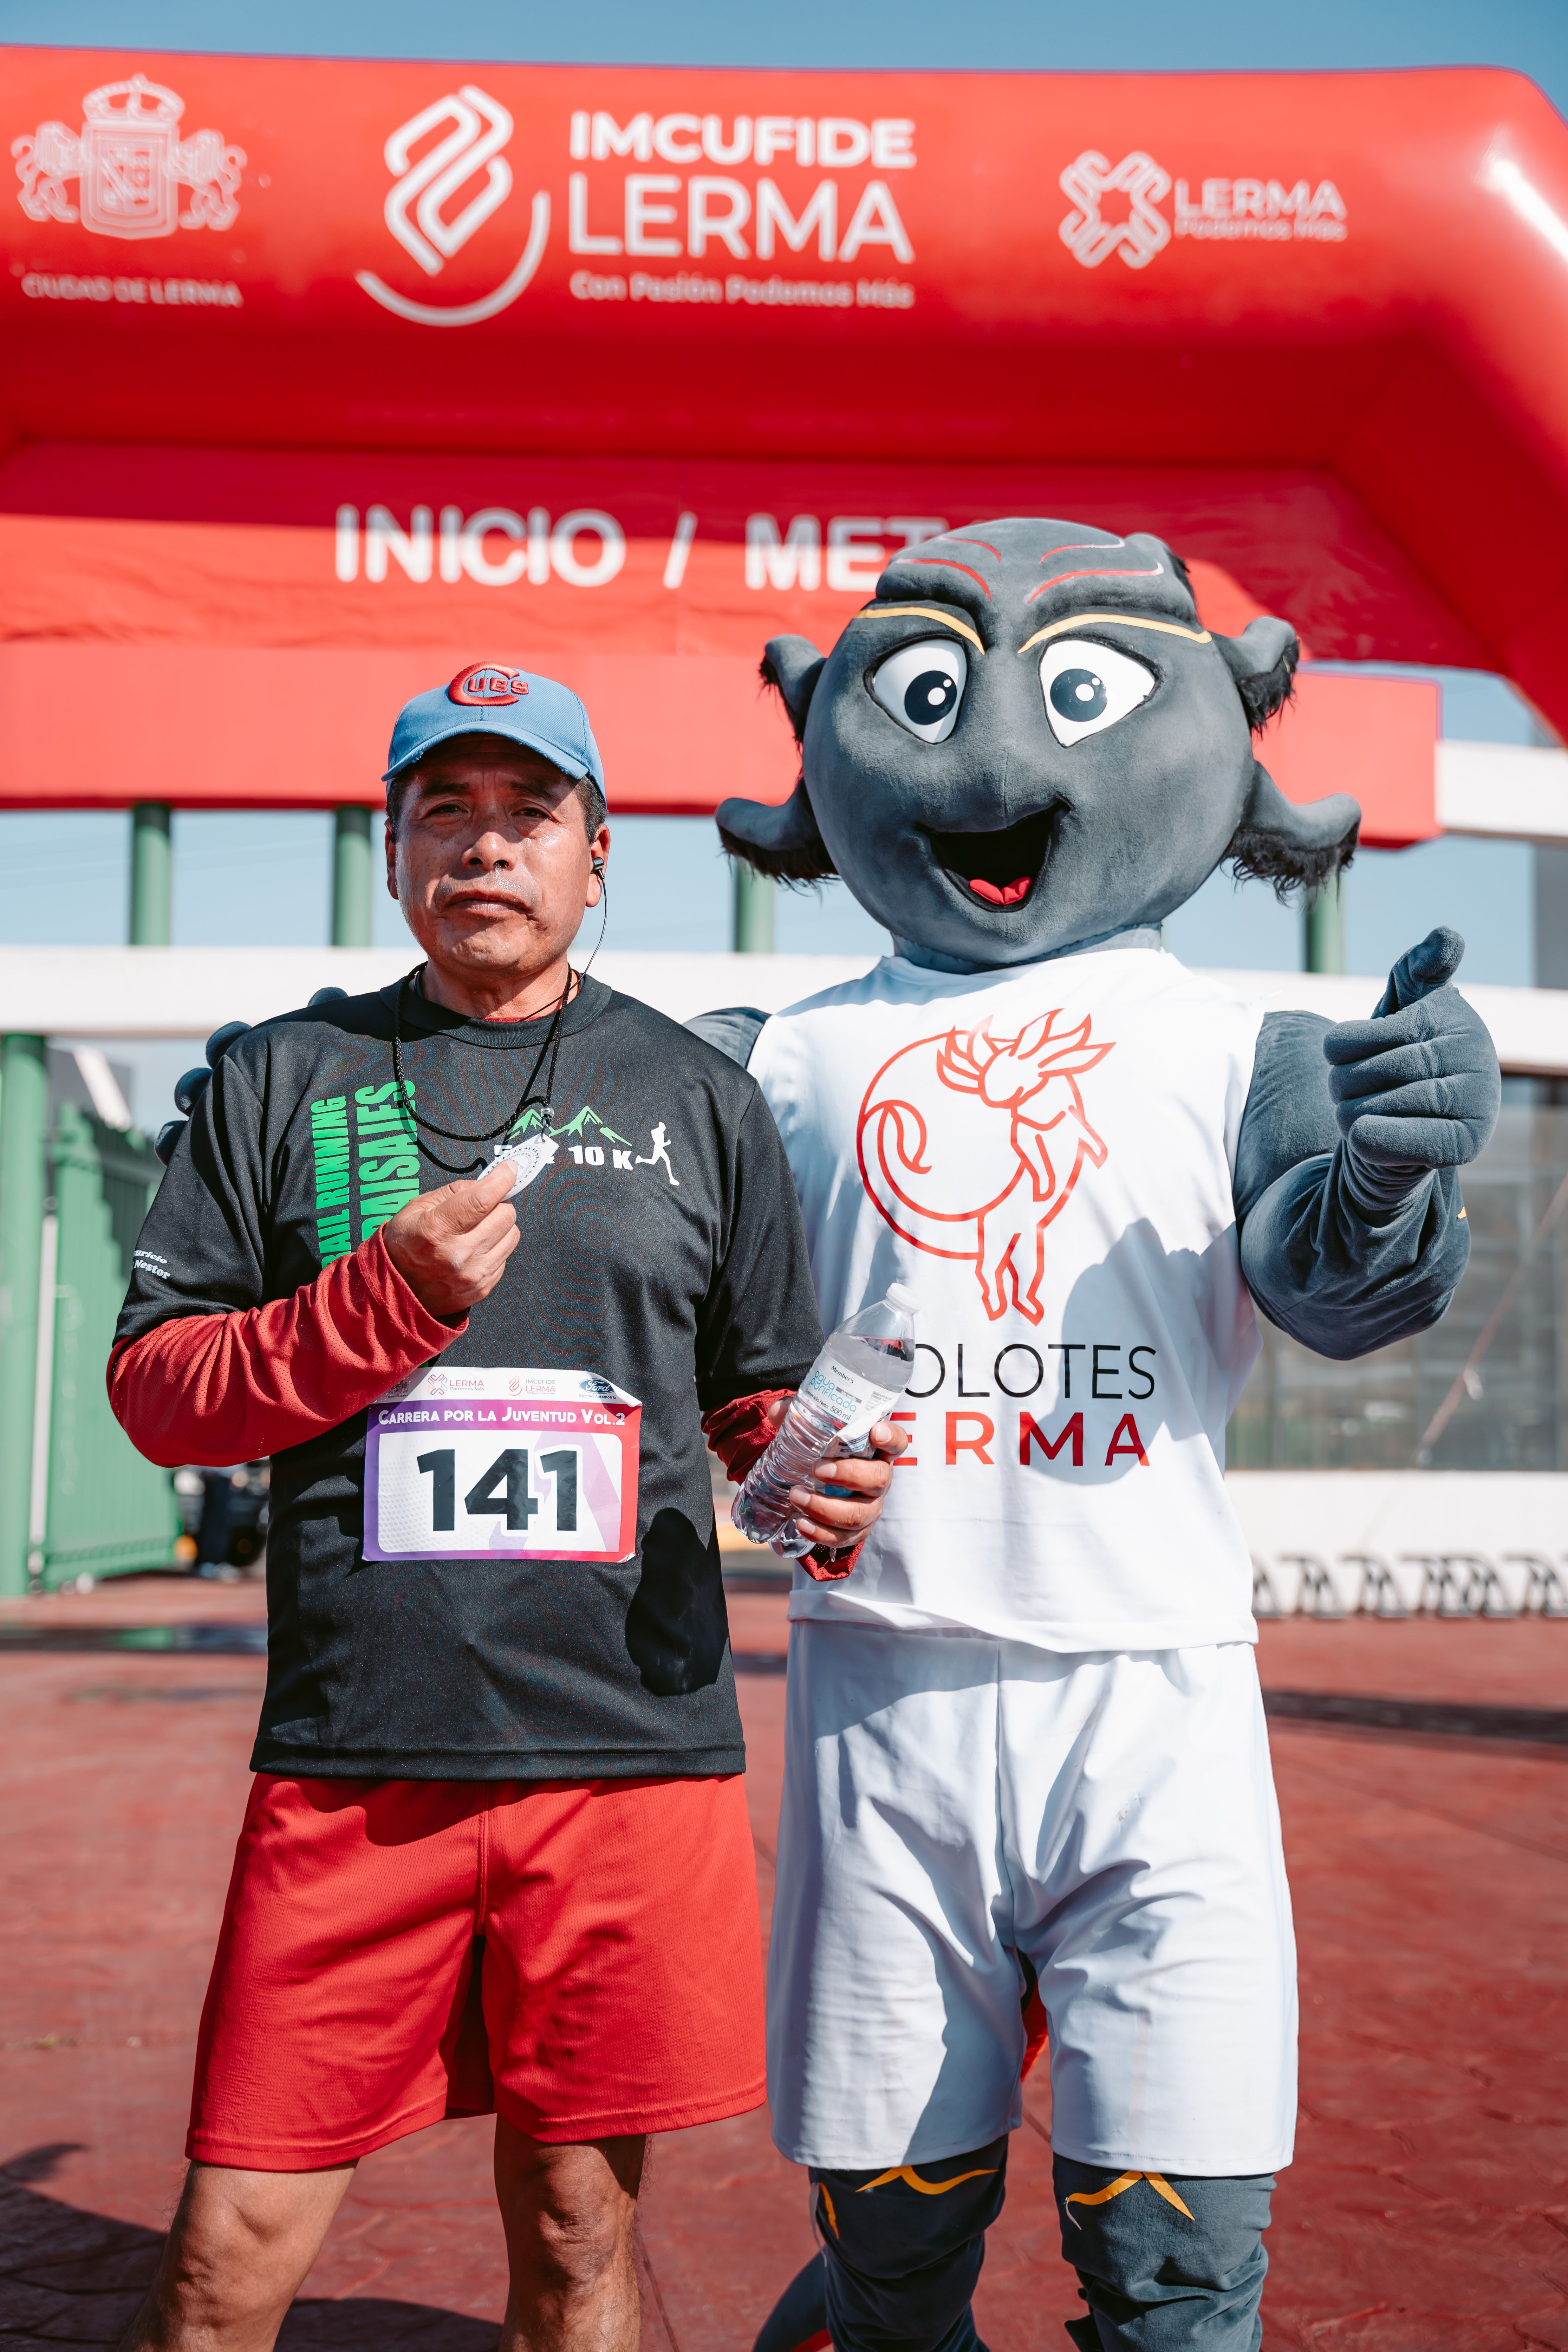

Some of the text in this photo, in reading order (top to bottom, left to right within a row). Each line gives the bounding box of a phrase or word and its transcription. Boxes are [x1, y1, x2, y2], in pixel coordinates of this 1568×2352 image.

[571, 112, 916, 168] IMCUFIDE
[1175, 178, 1347, 220] LERMA
[569, 172, 916, 264] LERMA
[22, 273, 243, 307] CIUDAD DE LERMA
[336, 505, 950, 591] INICIO / MET
[448, 660, 529, 706] CUBS
[311, 1096, 349, 1209] RUNNING
[568, 1145, 604, 1165] 10
[613, 1149, 633, 1170] K
[134, 1250, 168, 1264] uricio
[134, 1260, 170, 1279] Nestor
[585, 1380, 611, 1392] Ford
[814, 1371, 835, 1391] agua
[831, 1365, 854, 1384] Member's
[905, 1343, 1156, 1399] OLOTES
[805, 1388, 819, 1402] Contenido
[830, 1406, 842, 1416] 500
[809, 1378, 857, 1413] purificada
[378, 1410, 440, 1425] CARRERA
[444, 1410, 474, 1421] POR
[478, 1410, 497, 1421] LA
[501, 1406, 577, 1423] JUVENTUD
[890, 1411, 1150, 1467] ERMA
[416, 1449, 577, 1531] 141
